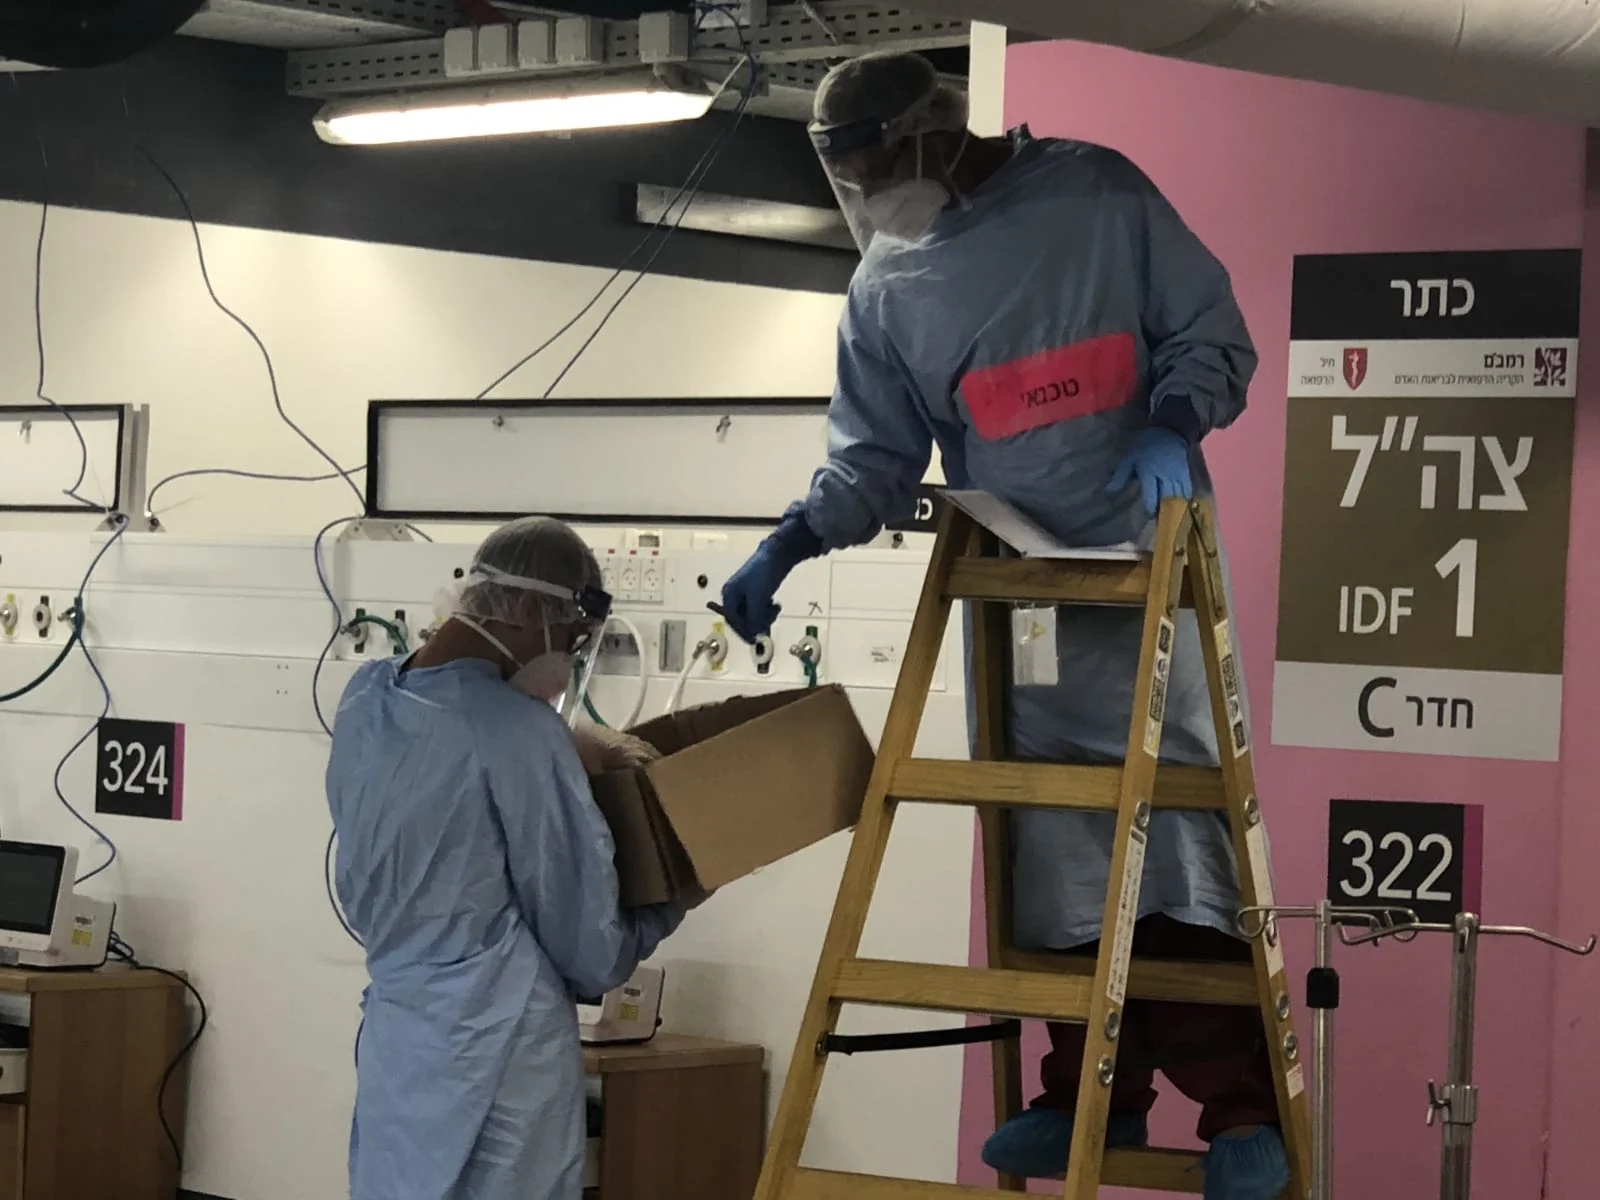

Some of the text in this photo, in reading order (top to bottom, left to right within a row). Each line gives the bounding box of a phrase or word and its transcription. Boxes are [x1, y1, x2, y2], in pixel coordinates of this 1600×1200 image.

[1390, 278, 1475, 317] כתר
[1301, 375, 1335, 384] הרפואה
[1395, 375, 1419, 384] האדם
[1331, 415, 1534, 511] צה"ל
[1339, 538, 1478, 637] IDF 1
[1358, 676, 1473, 737] חדר C
[103, 740, 168, 795] 324
[1340, 829, 1453, 901] 322
